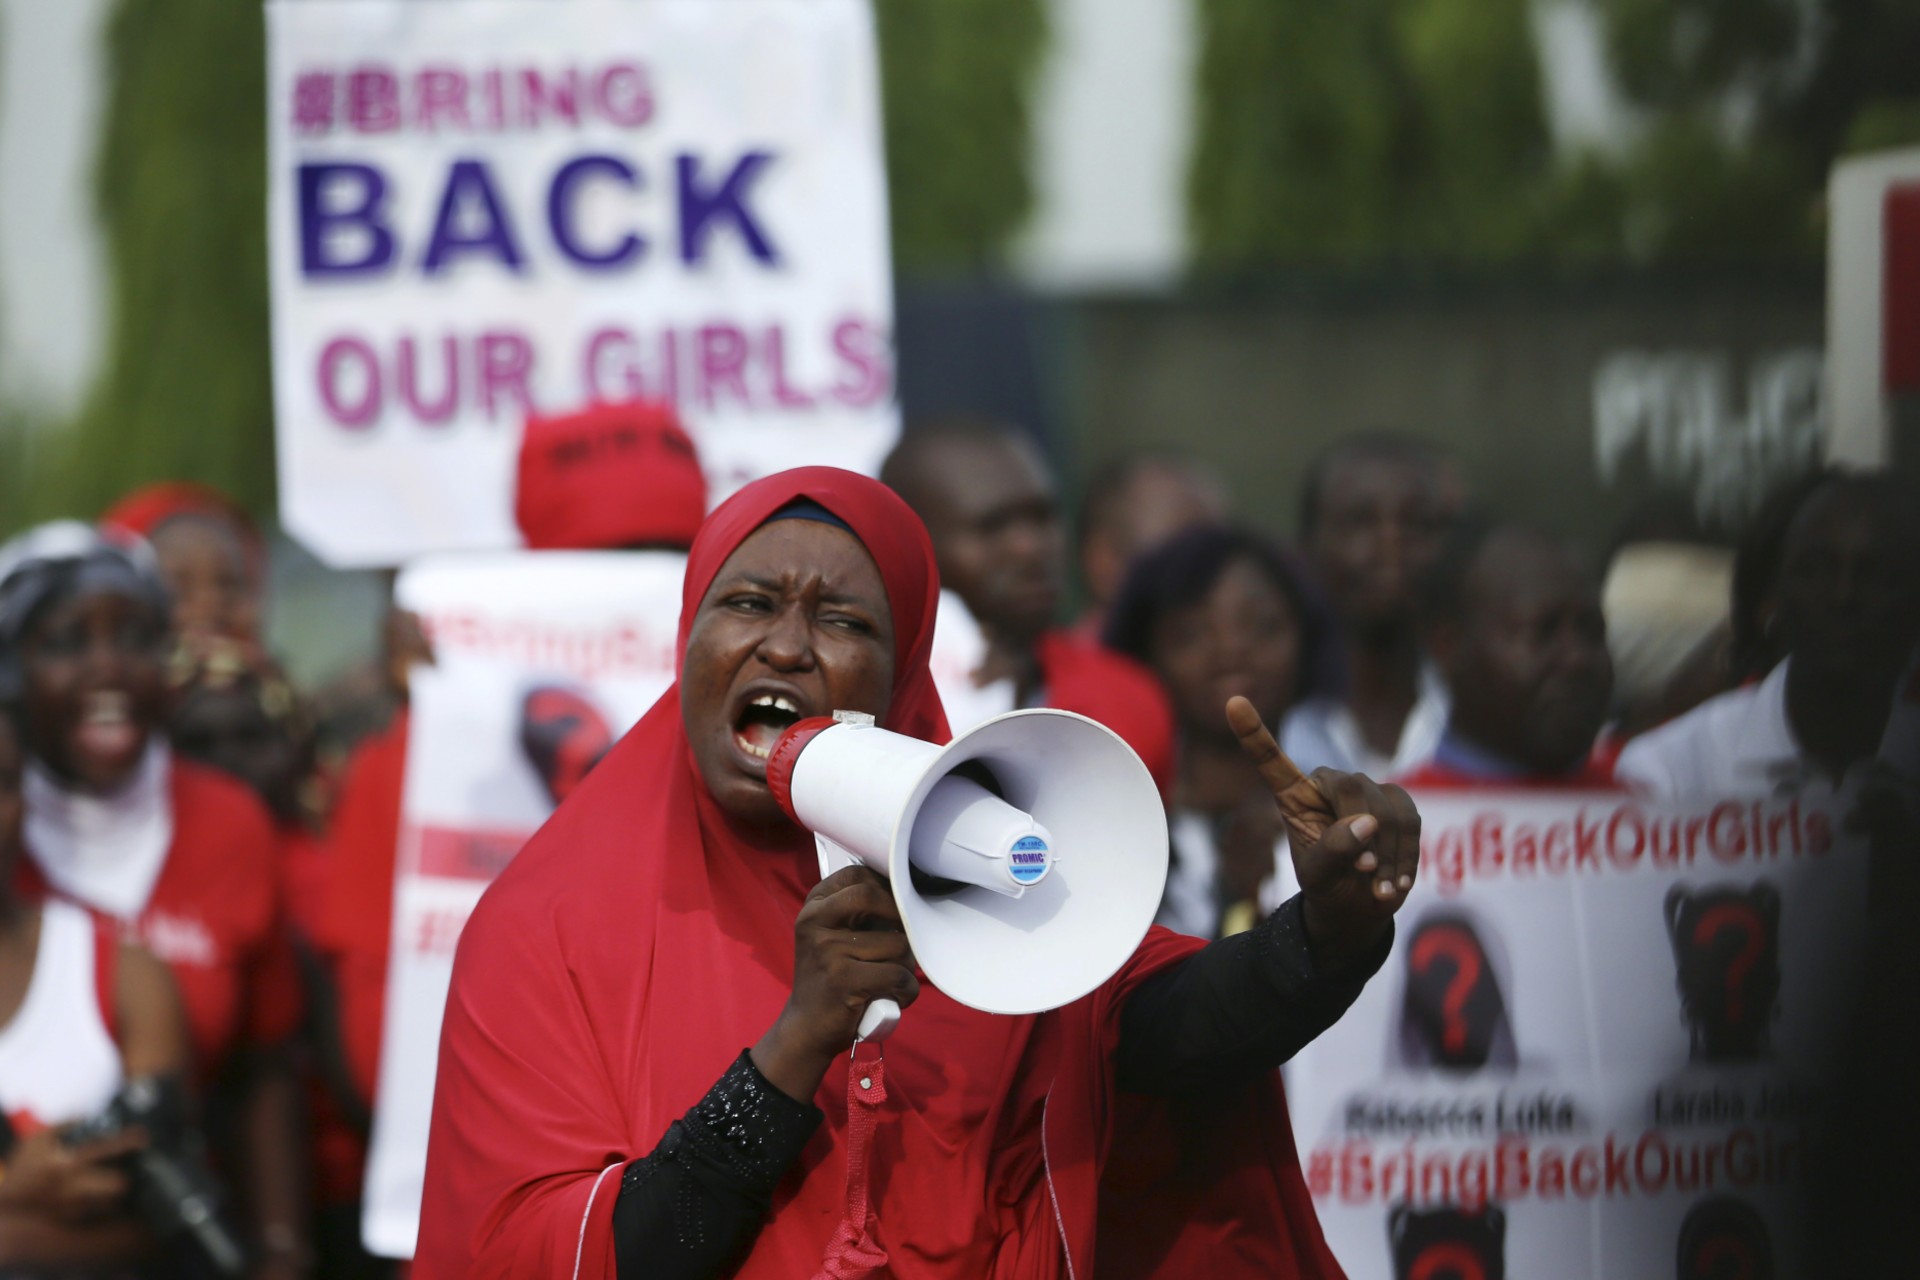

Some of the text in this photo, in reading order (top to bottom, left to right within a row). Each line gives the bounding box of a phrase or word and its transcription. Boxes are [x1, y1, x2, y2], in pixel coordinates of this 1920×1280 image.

[291, 62, 656, 133] #BRING
[296, 151, 782, 282] BACK
[316, 333, 536, 431] OUR
[584, 318, 892, 411] GIRLS
[1012, 853, 1044, 864] PROMIC
